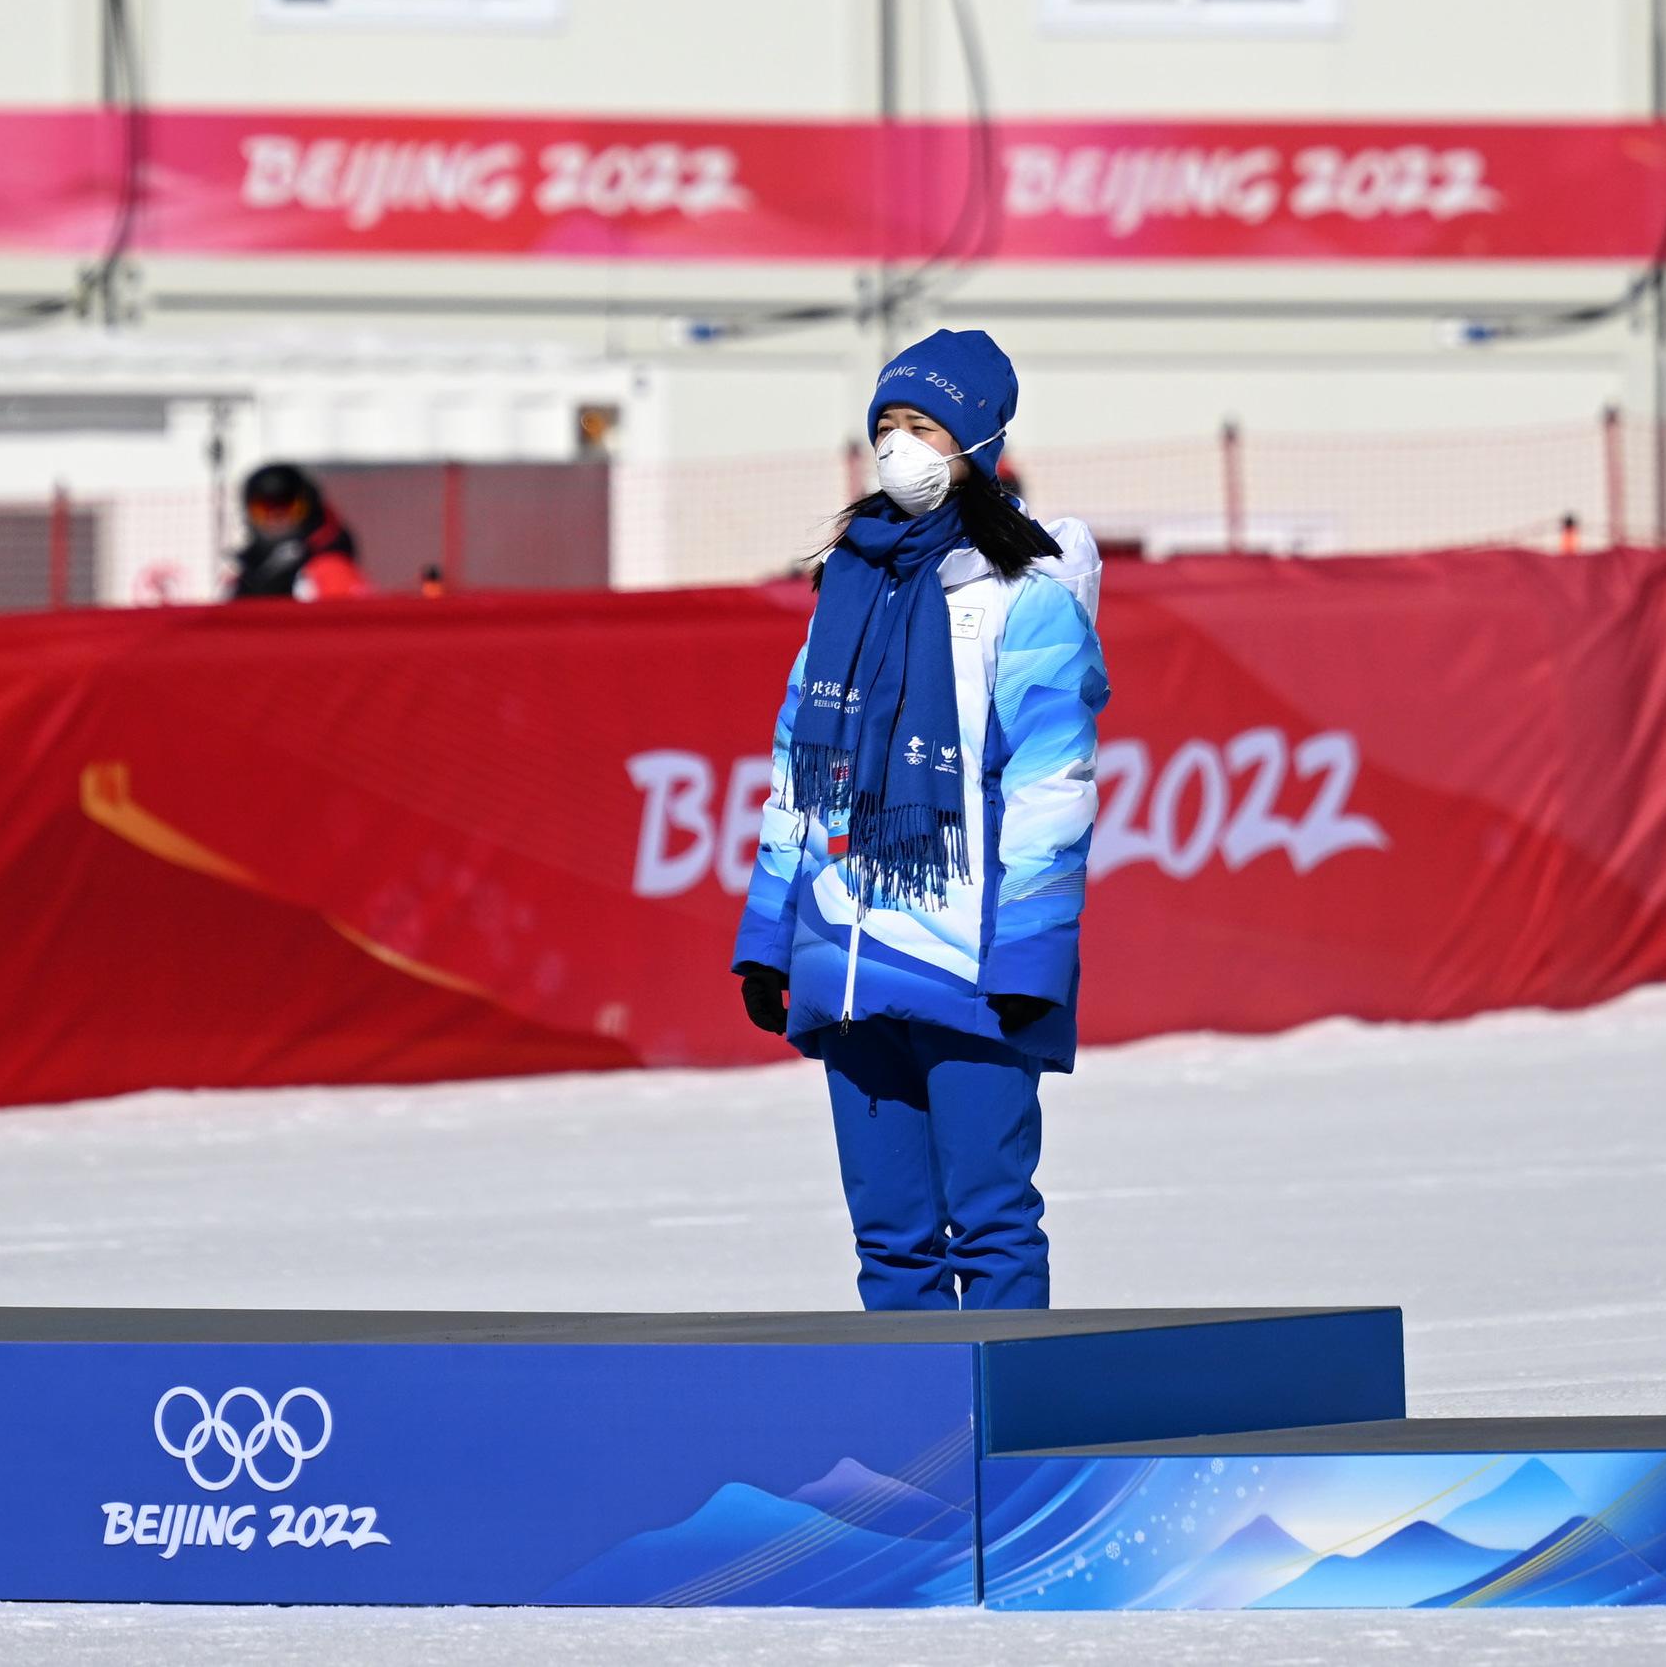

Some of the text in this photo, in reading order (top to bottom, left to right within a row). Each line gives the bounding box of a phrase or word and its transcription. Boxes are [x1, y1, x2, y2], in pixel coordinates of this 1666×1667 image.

[241, 134, 753, 227] BEIJING 2022
[1004, 144, 1507, 234] BEIJING 2022
[926, 372, 965, 405] 2022
[1086, 725, 1393, 882] 2022
[101, 1501, 391, 1559] BEIJING 2022
